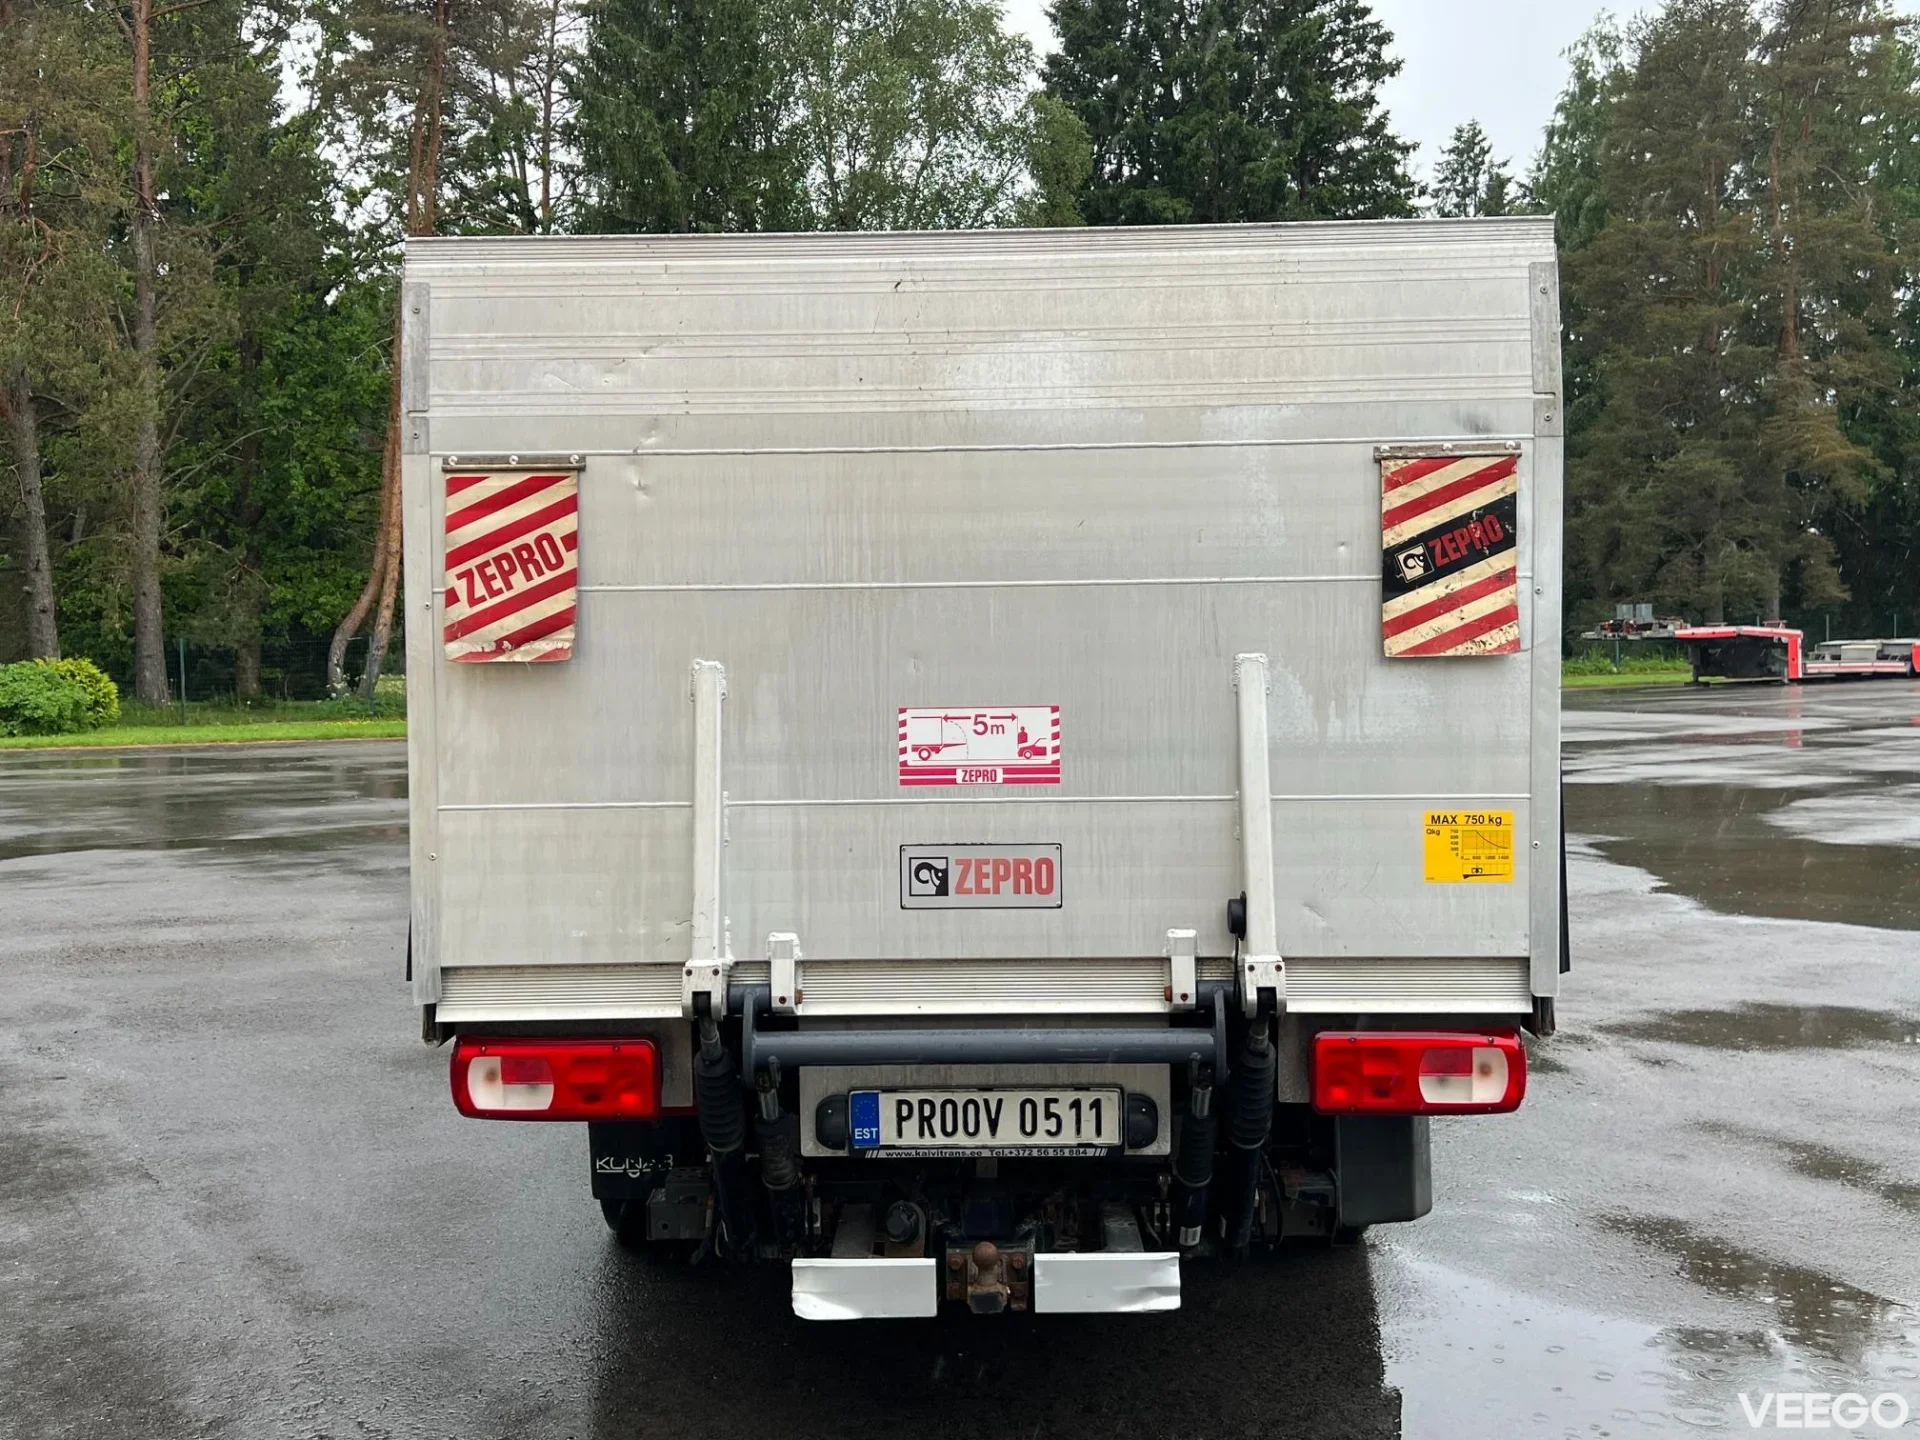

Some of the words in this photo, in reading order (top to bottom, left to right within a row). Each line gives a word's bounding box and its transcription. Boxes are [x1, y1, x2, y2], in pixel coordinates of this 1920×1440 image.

[1428, 514, 1504, 567] ZEPRO
[455, 532, 565, 608] ZEPRO
[961, 769, 997, 783] ZEPRO
[1431, 815, 1458, 824] MAX
[1464, 815, 1485, 824] 750
[1488, 815, 1502, 826] kg
[954, 857, 1054, 895] ZEPRO
[854, 1127, 878, 1140] EST
[1019, 1097, 1103, 1138] 0511
